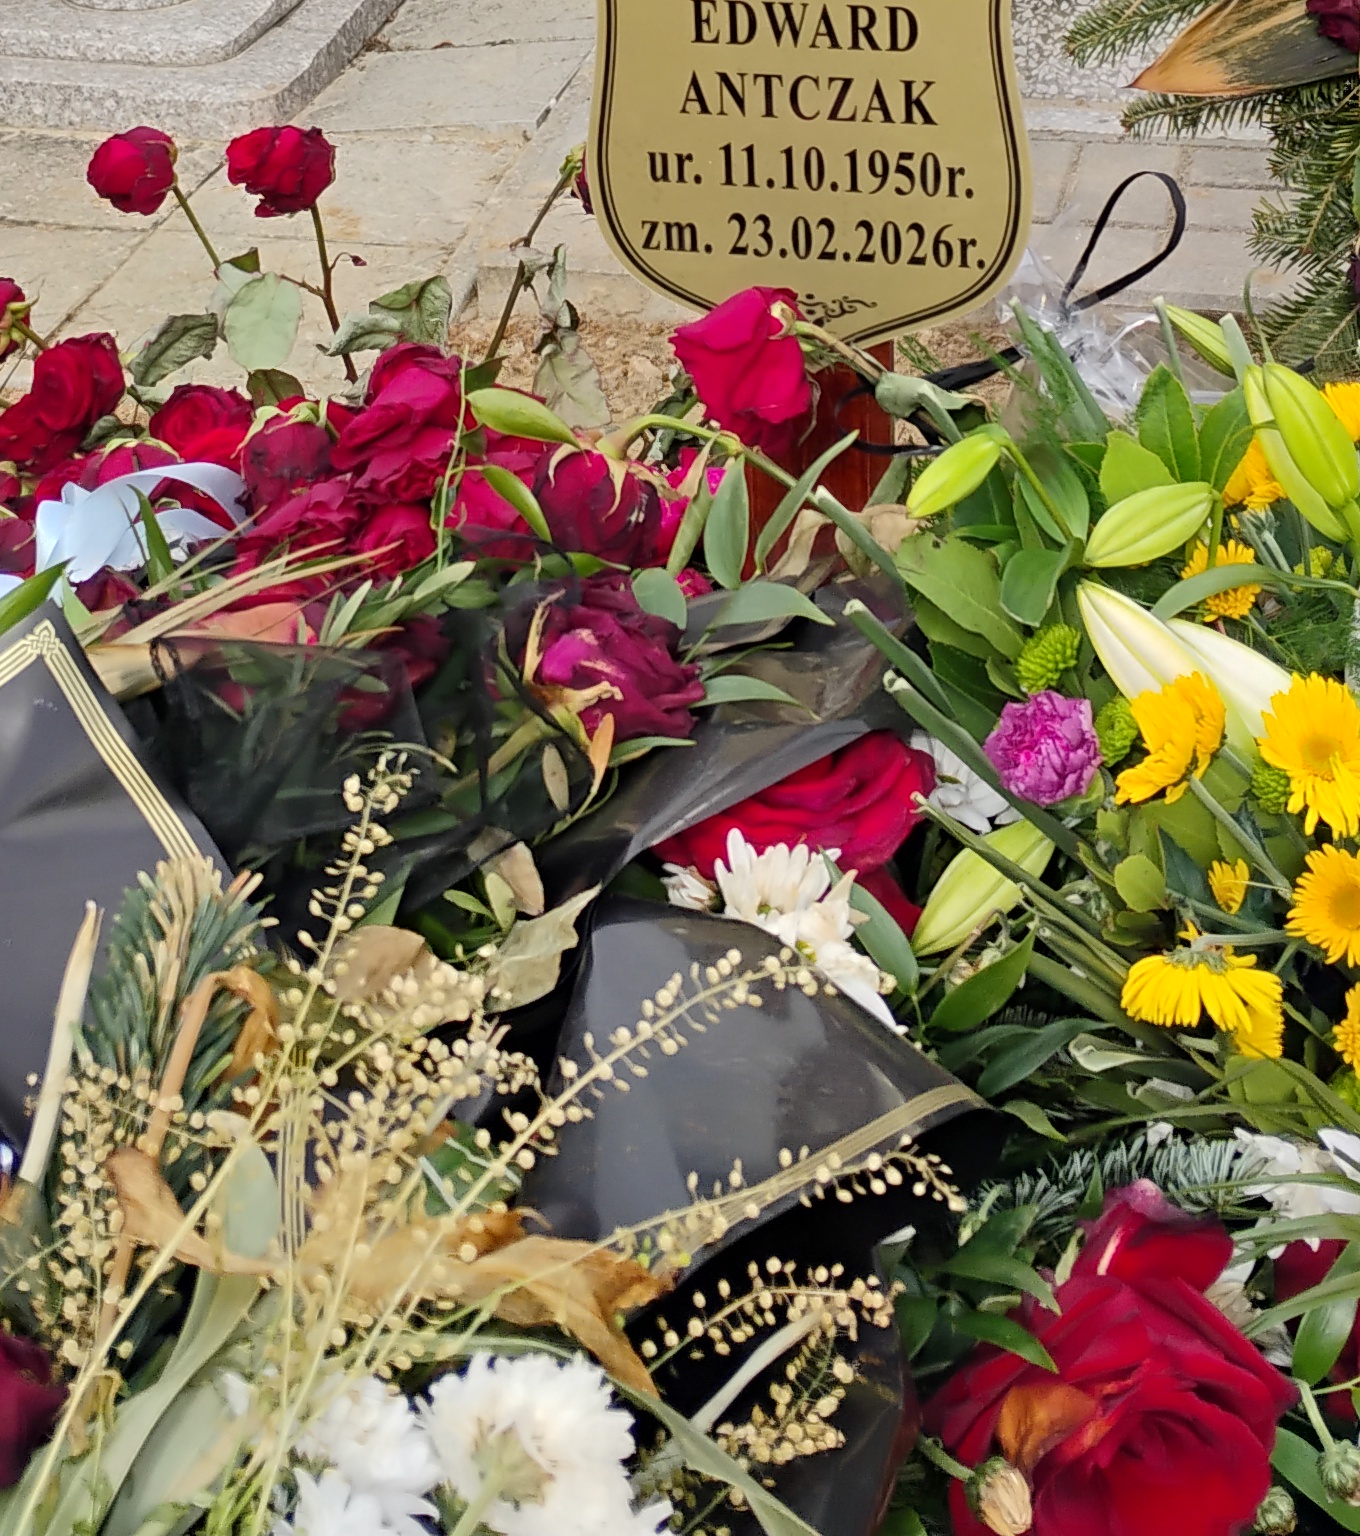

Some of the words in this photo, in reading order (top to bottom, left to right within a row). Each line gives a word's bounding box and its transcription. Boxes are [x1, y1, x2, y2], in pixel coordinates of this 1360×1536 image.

[679, 71, 939, 126] ANTCZAK
[646, 148, 703, 185] ur.
[719, 142, 975, 200] 11.10.1950r.
[641, 217, 714, 255] zm.
[727, 212, 987, 270] 23.02.2026r.
